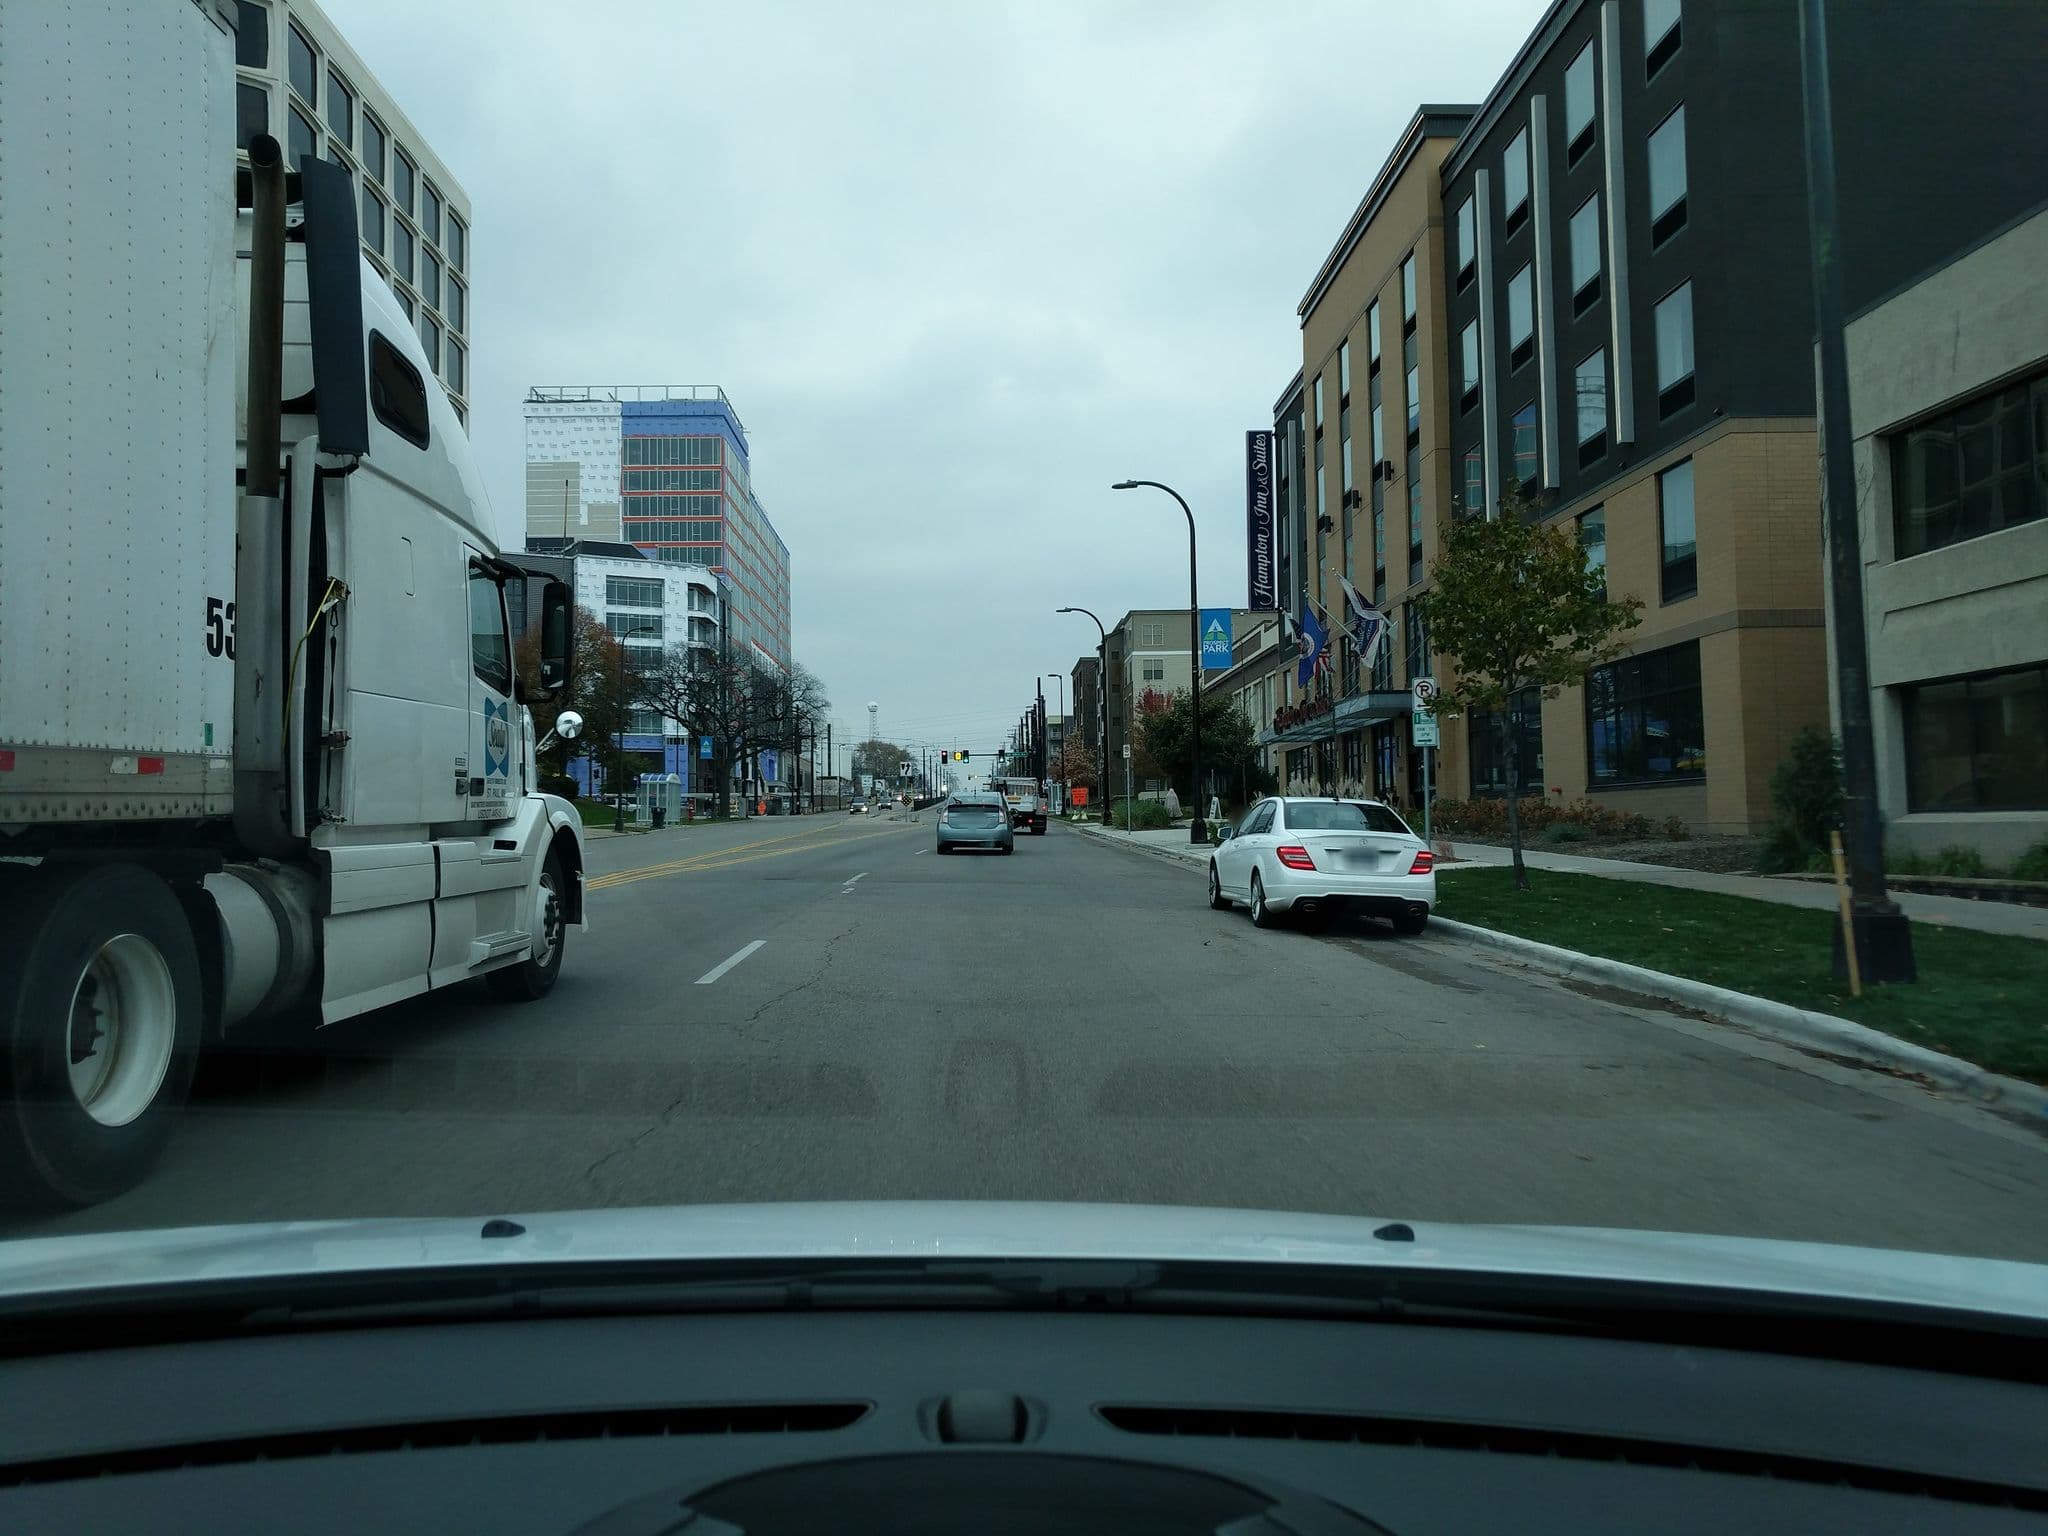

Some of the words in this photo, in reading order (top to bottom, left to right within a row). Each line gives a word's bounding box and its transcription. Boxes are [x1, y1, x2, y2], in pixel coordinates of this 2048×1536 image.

[1252, 433, 1268, 476] Suites
[1253, 484, 1271, 525] Inn
[1253, 526, 1273, 606] Hampton
[1203, 645, 1229, 653] PARK
